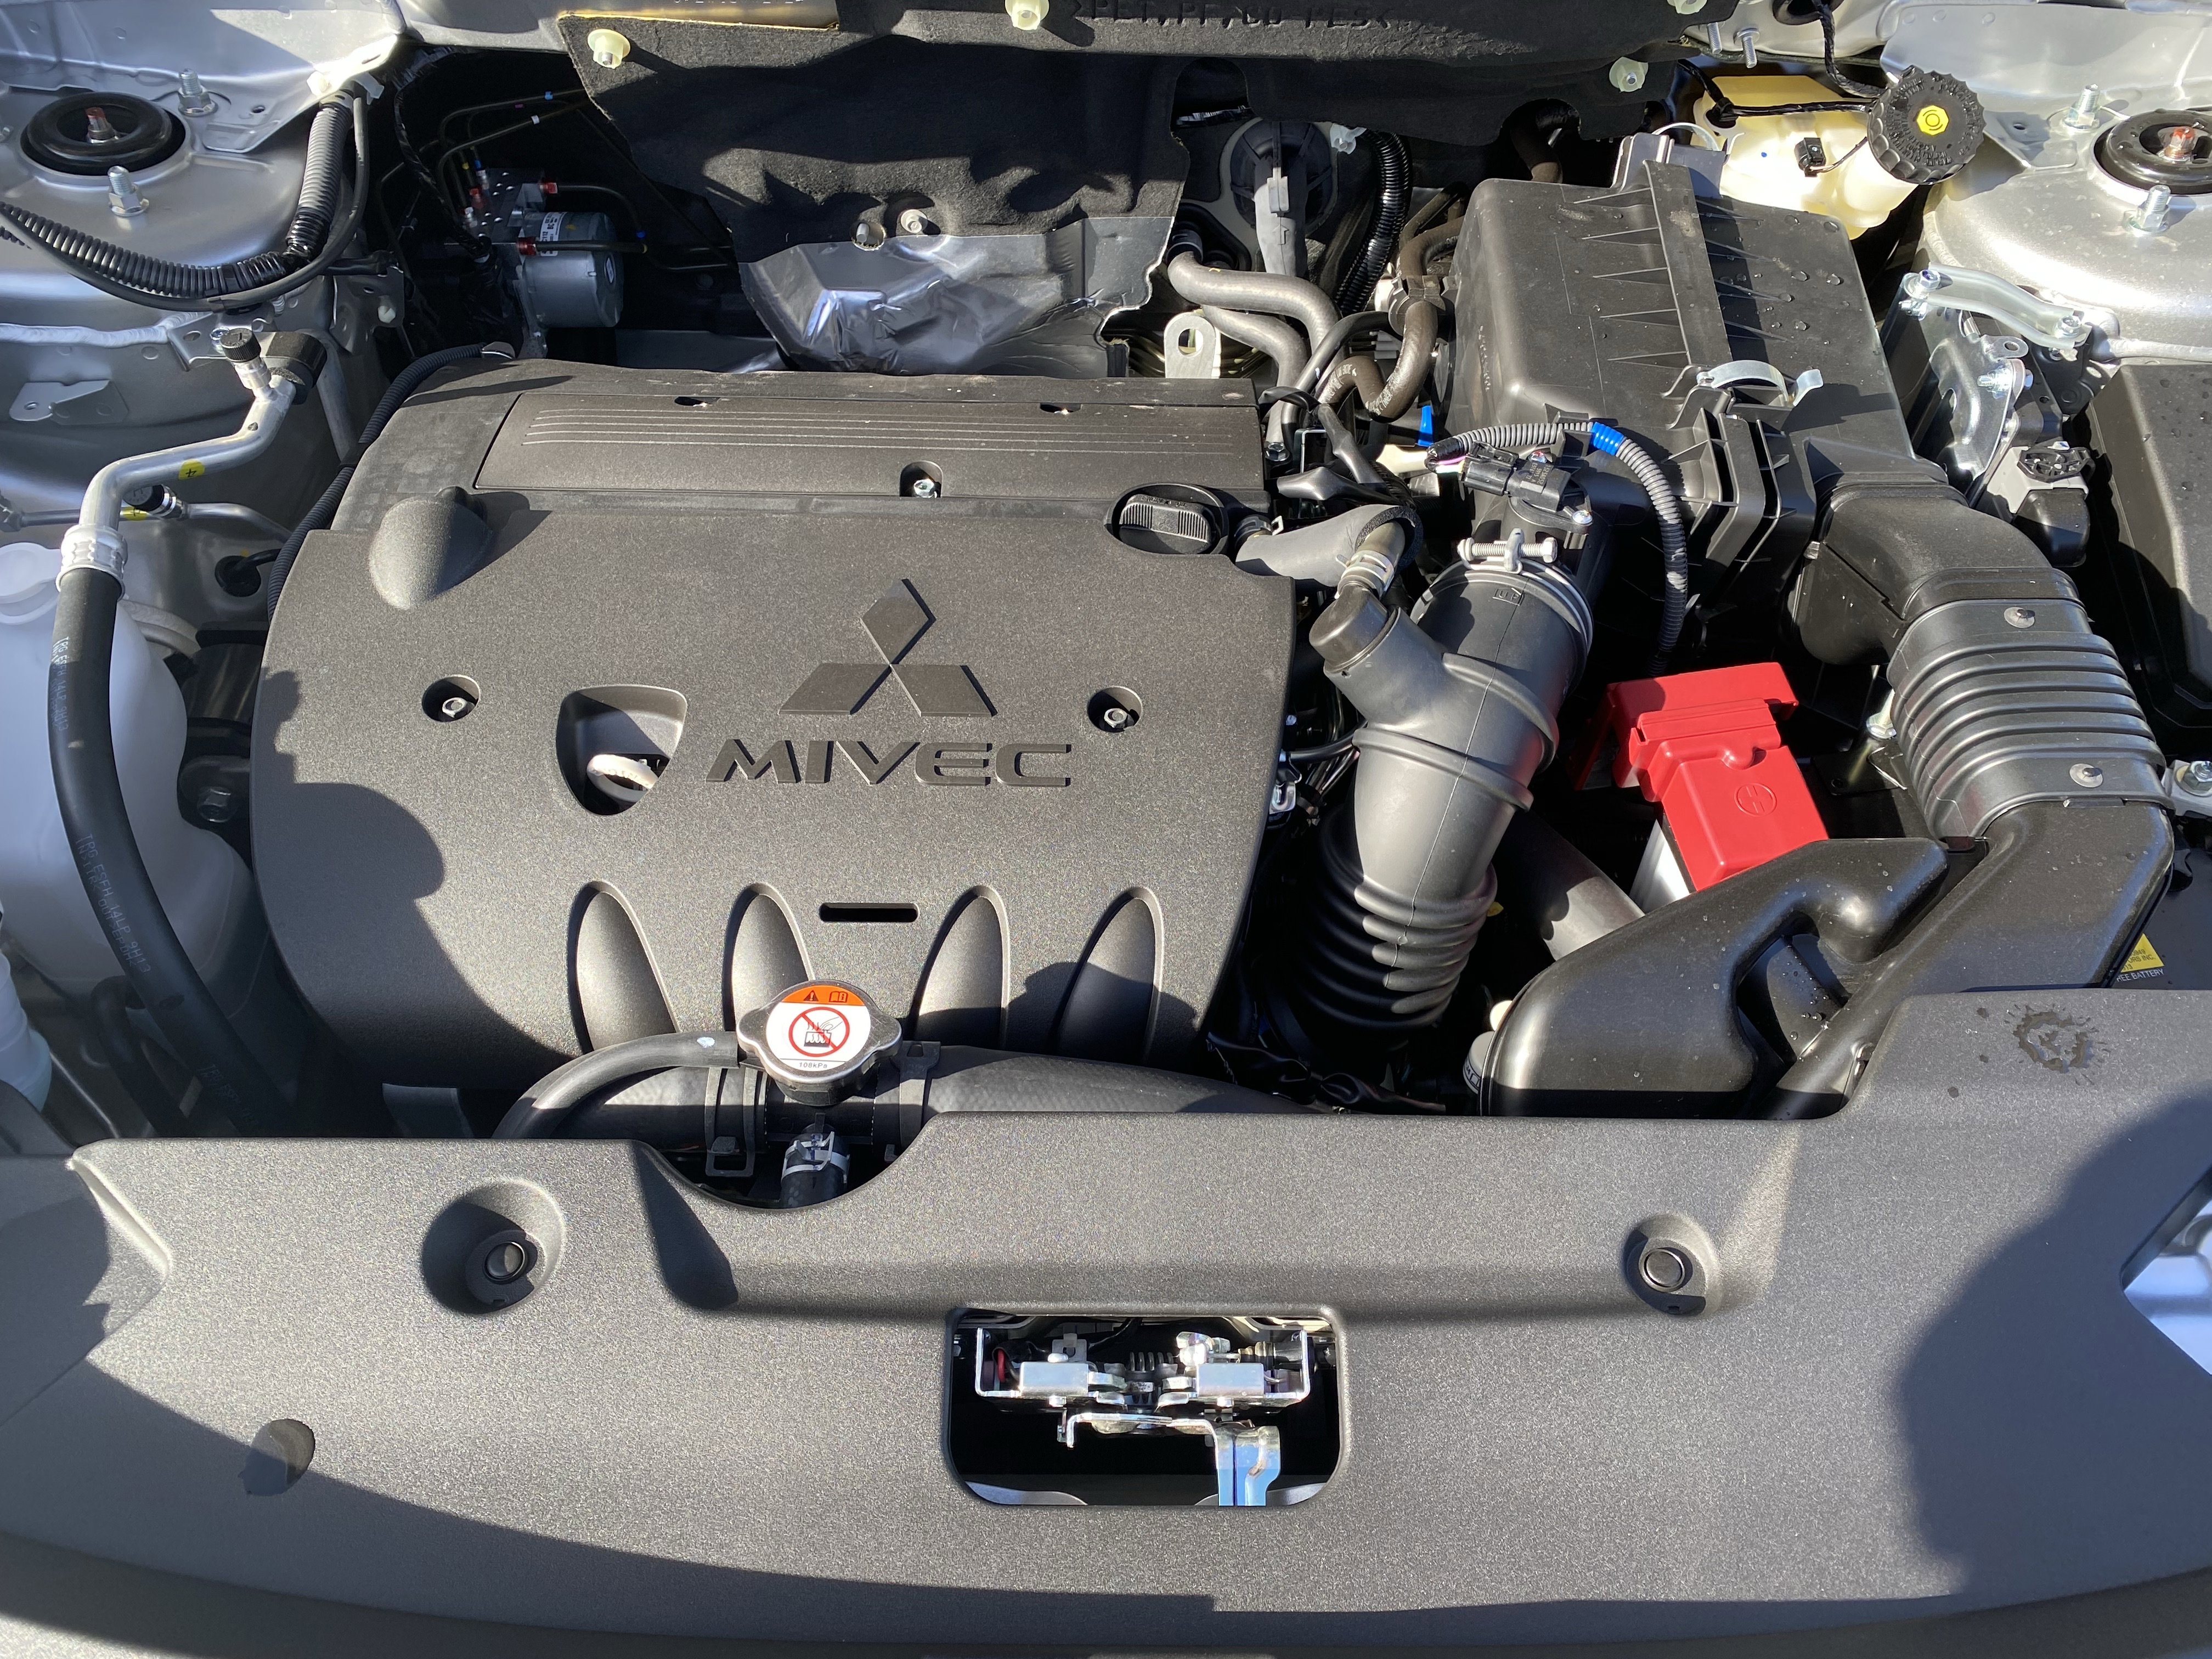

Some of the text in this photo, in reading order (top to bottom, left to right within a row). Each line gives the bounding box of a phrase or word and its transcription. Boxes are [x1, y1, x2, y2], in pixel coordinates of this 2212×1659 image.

[1499, 590, 1519, 601] UP
[705, 738, 1073, 787] MIVEC
[84, 833, 99, 859] TRG
[93, 864, 114, 897] ESFH
[128, 941, 151, 973] 9H13
[2131, 968, 2164, 979] BATTERY
